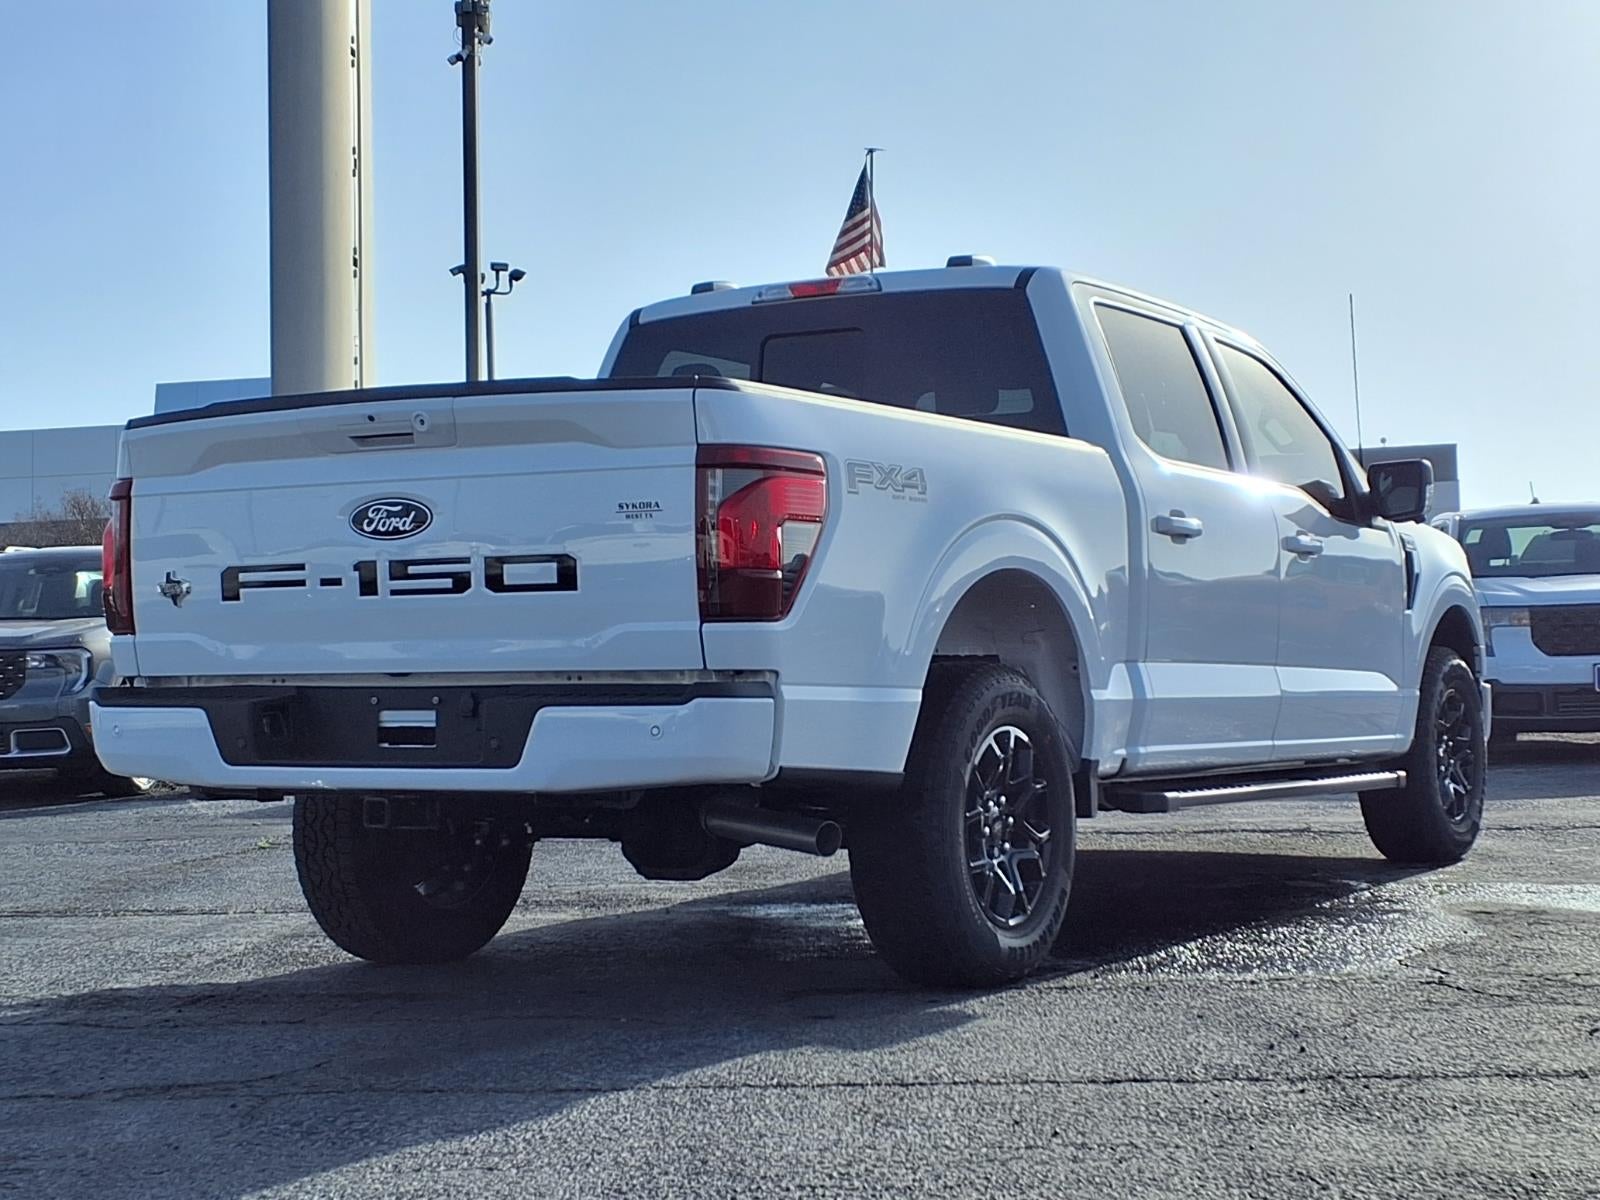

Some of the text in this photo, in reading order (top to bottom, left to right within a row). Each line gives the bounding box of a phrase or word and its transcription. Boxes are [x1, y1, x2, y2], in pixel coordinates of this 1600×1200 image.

[845, 459, 927, 495] FX4
[363, 505, 416, 532] Ford
[617, 501, 661, 511] SYKORA
[221, 553, 578, 602] F-150
